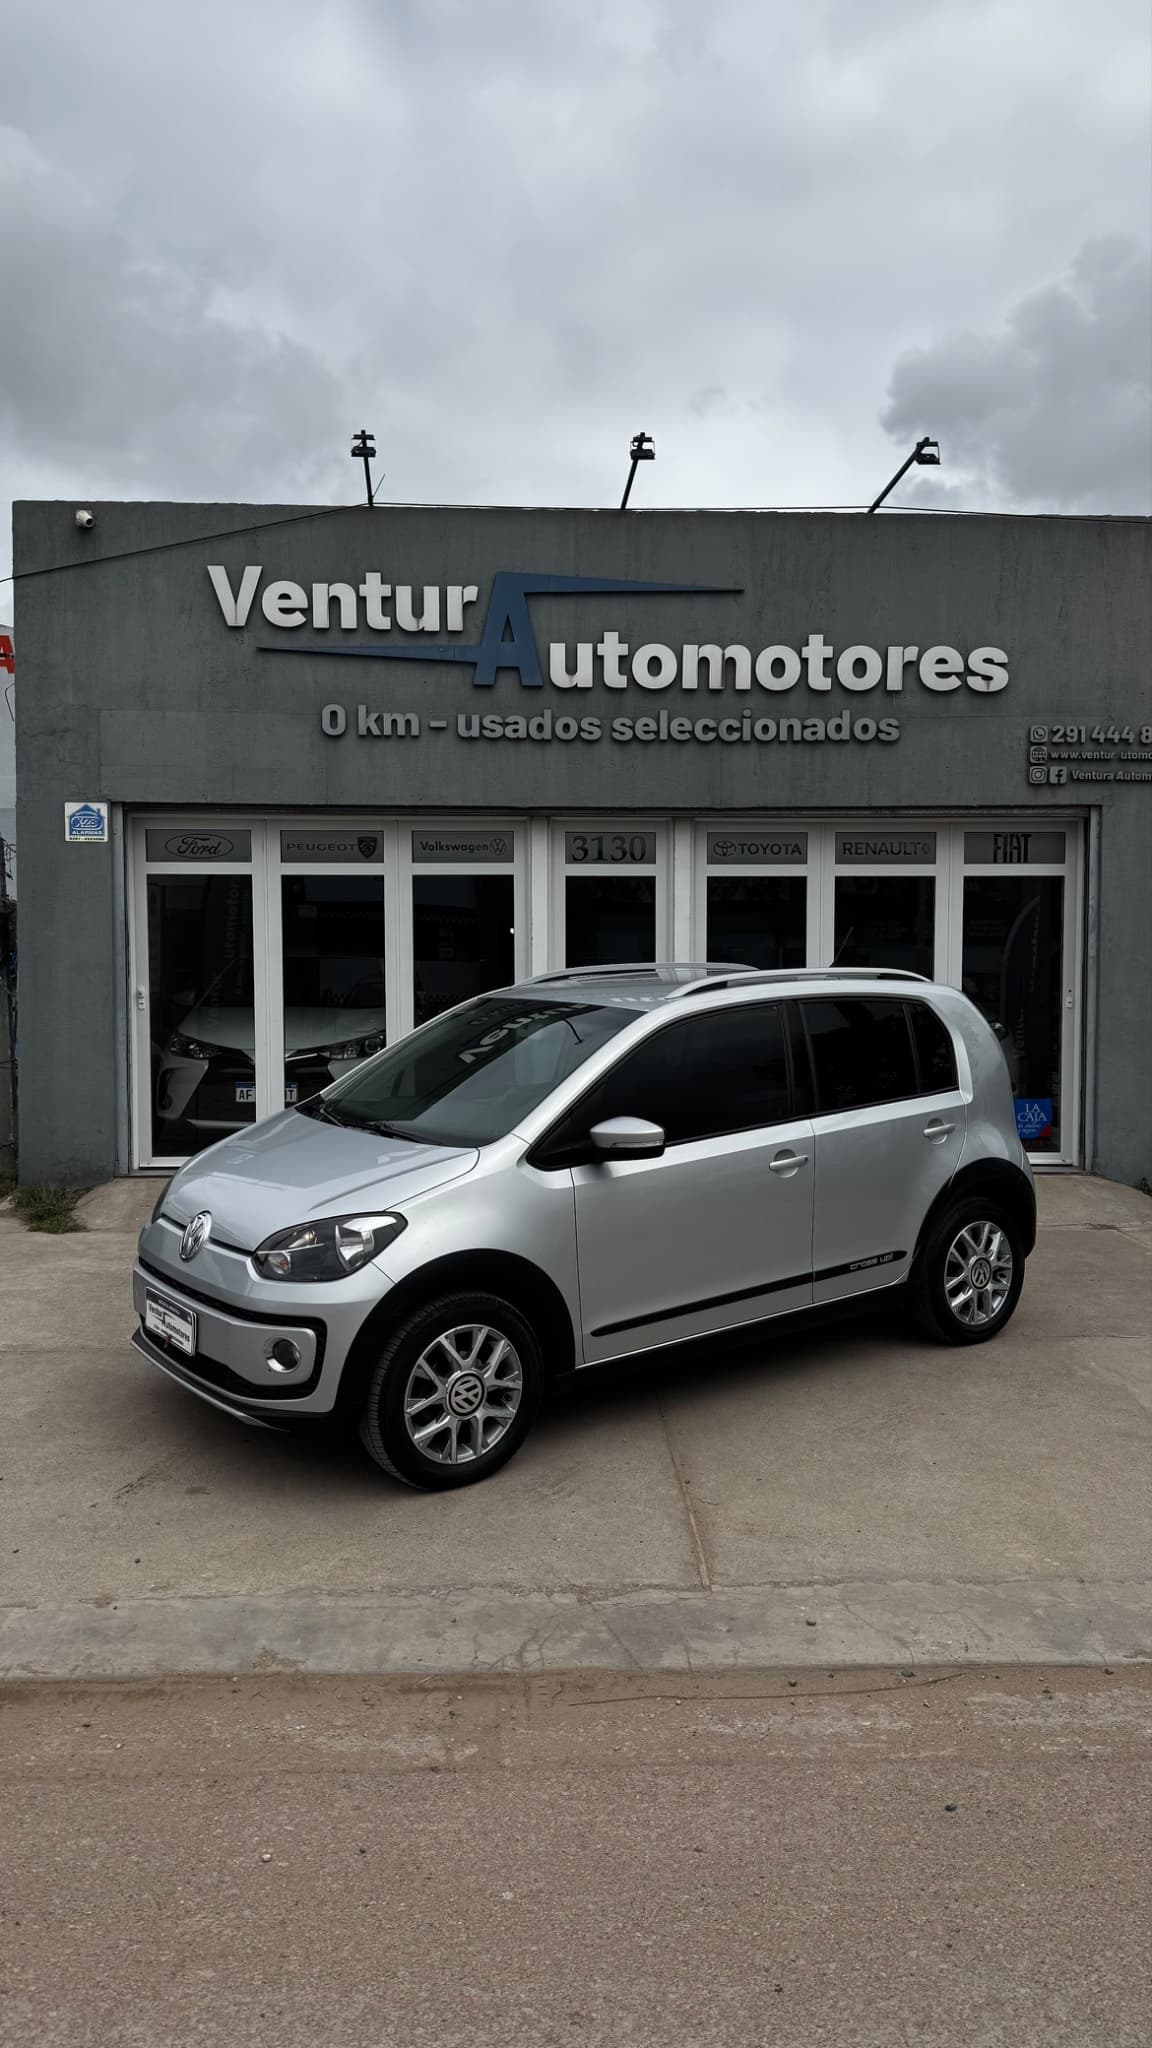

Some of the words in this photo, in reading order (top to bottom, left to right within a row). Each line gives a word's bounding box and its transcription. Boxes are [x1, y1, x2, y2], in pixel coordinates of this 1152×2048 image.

[321, 703, 347, 736] 0
[357, 704, 420, 736] km
[457, 709, 602, 741] usados
[611, 708, 900, 742] seleccionados
[1051, 725, 1087, 743] 291
[1092, 725, 1135, 743] 444
[1071, 769, 1114, 781] Ventura
[177, 836, 221, 855] Ford
[286, 842, 356, 852] PEUGEOT
[420, 840, 489, 853] Volkswagen
[572, 835, 646, 862] 3130
[738, 843, 802, 856] TOYOTA
[842, 842, 920, 856] RENAULT
[992, 833, 1033, 864] FIAT
